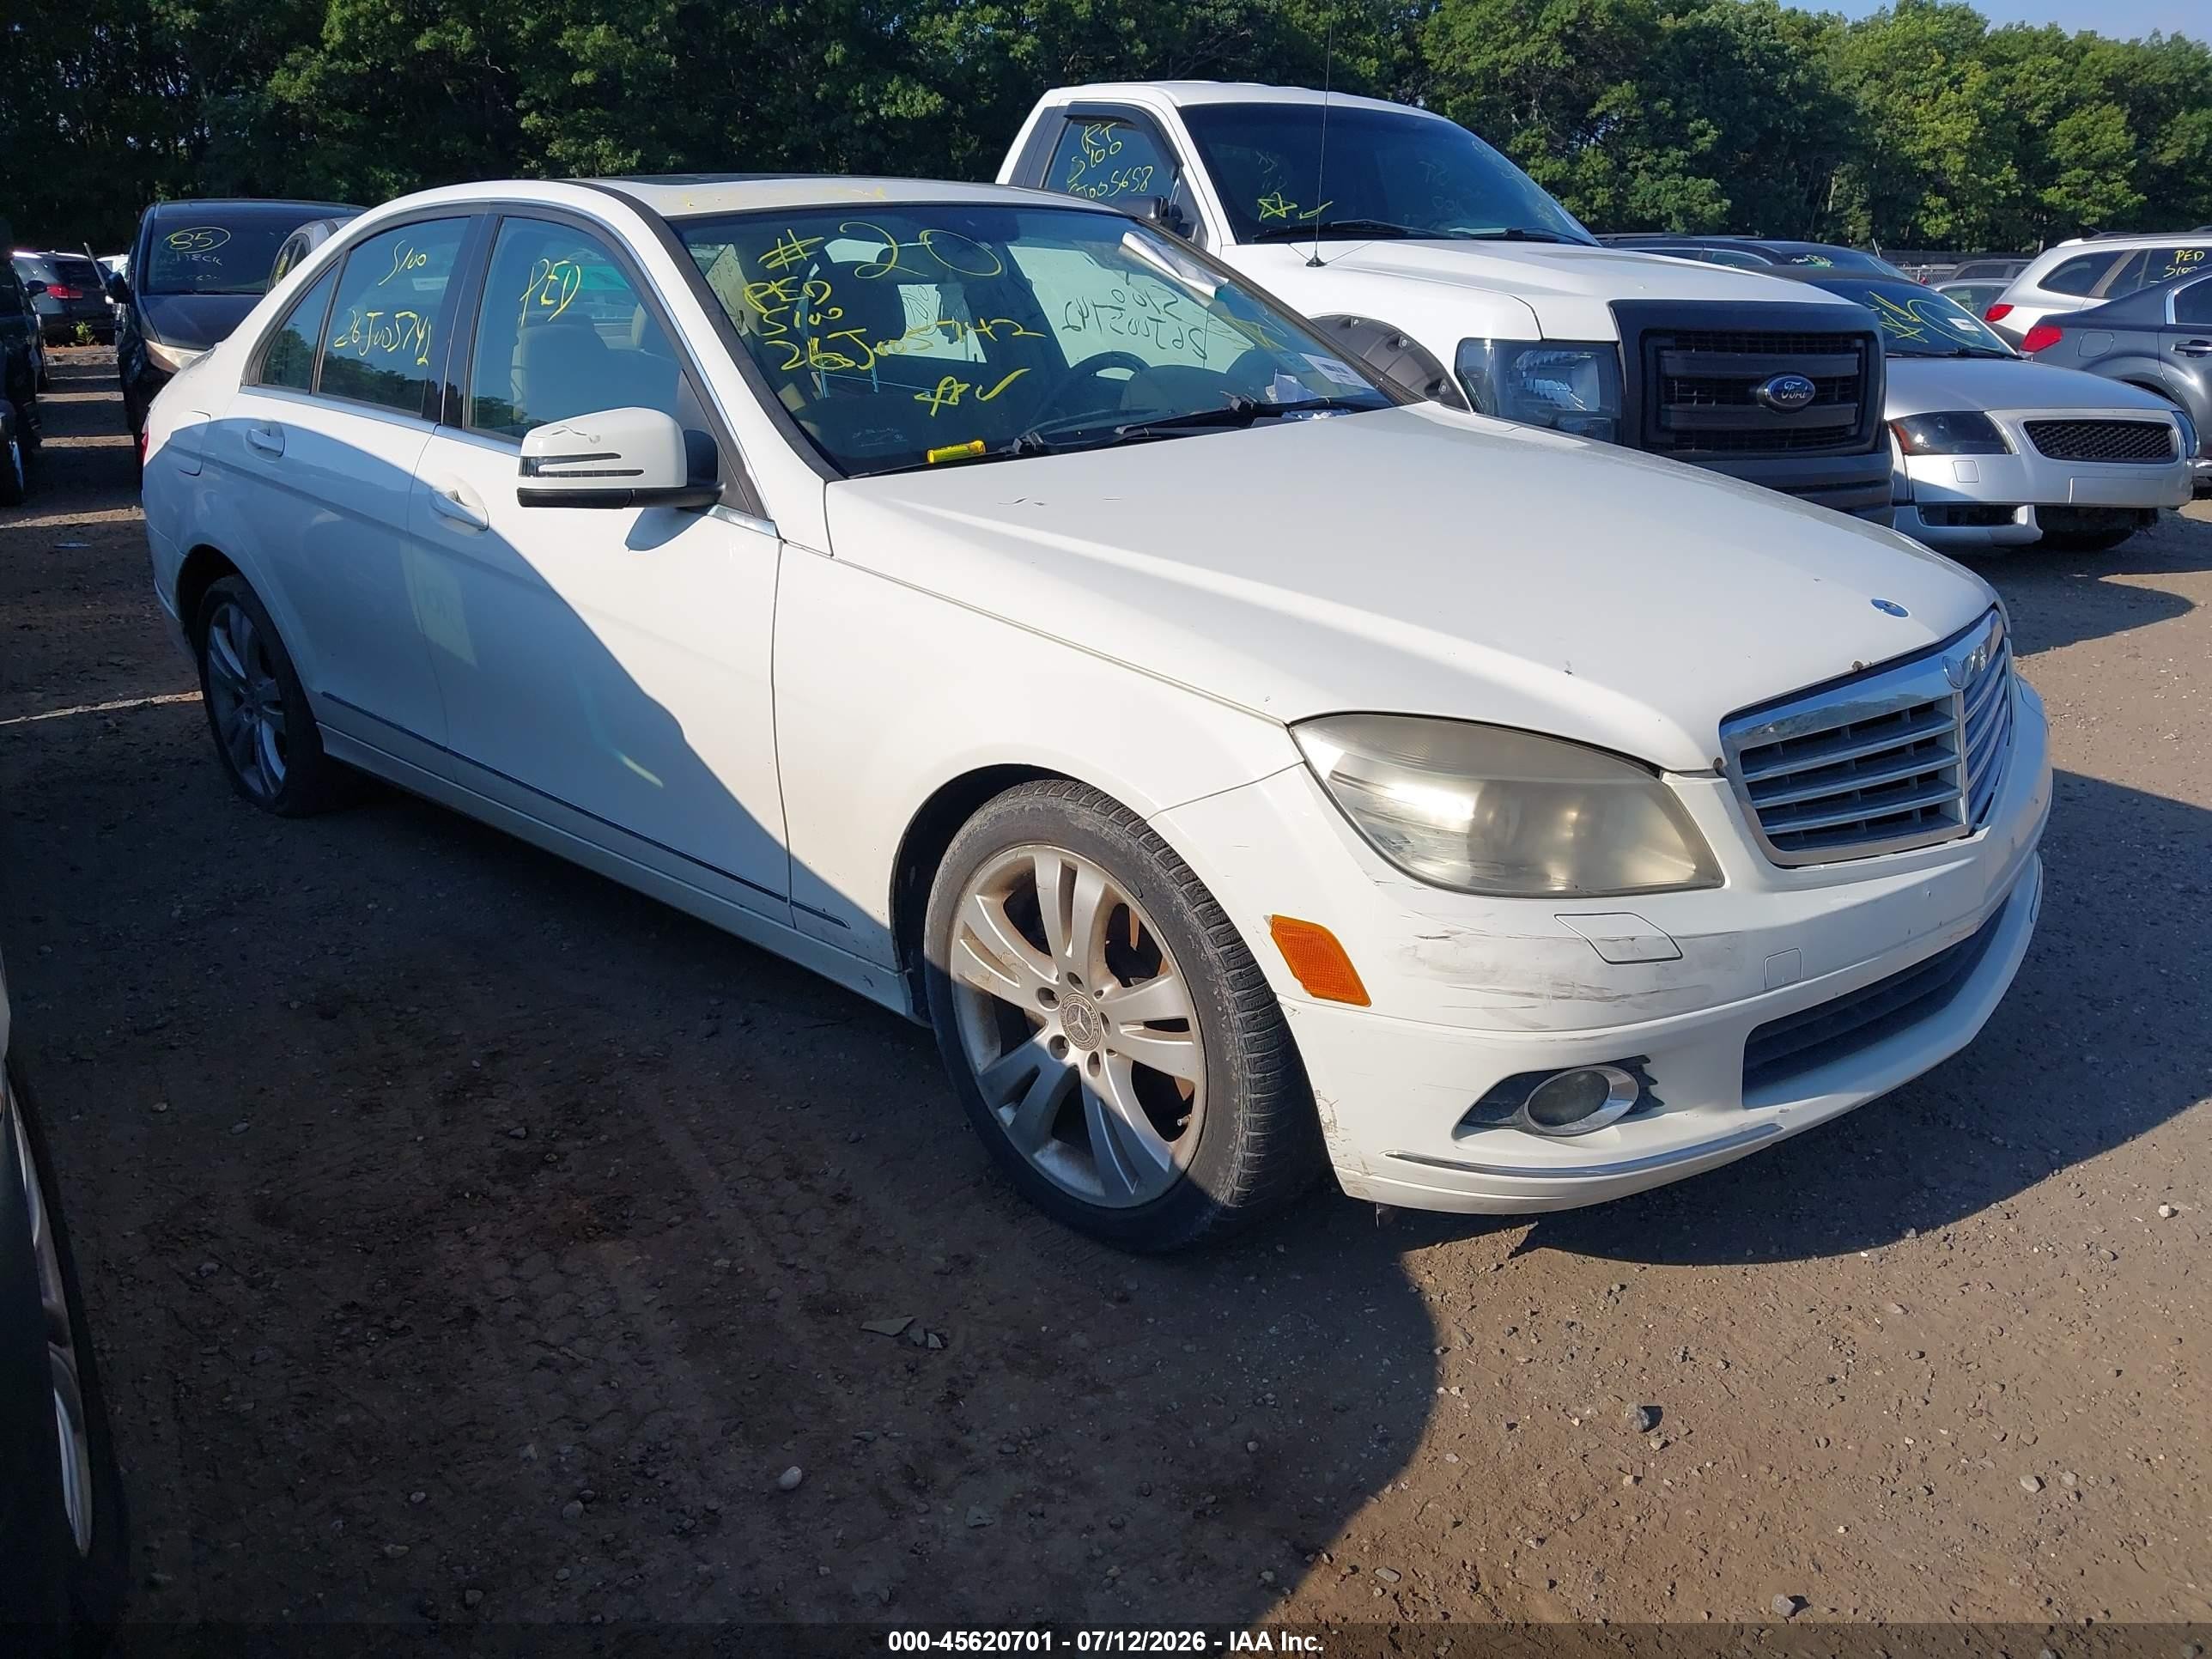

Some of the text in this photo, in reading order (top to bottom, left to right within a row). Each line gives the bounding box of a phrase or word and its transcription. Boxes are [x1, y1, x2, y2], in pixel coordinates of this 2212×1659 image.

[169, 230, 214, 250] 85
[2174, 249, 2206, 264] PED
[519, 258, 581, 327] PED
[742, 276, 833, 313] PED
[1781, 380, 1808, 399] Ford
